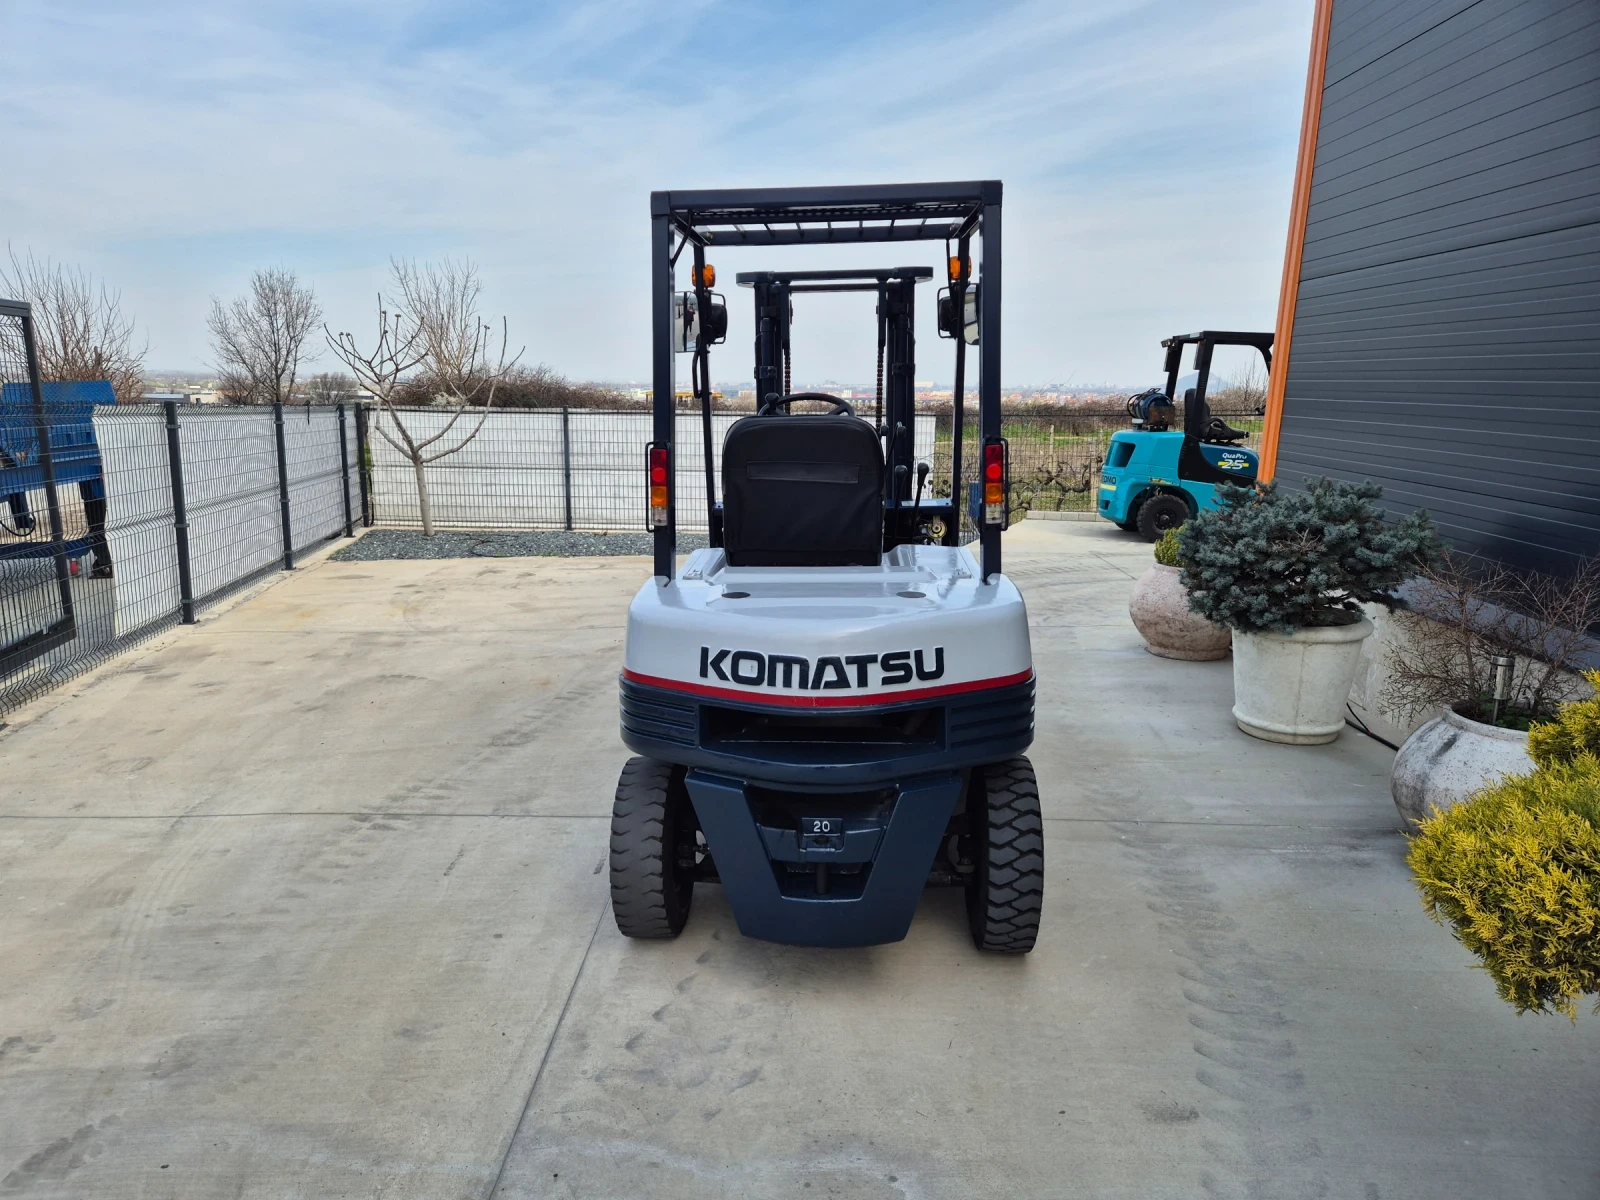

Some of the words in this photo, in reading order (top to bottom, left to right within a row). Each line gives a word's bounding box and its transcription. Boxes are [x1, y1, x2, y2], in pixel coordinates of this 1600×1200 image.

[1221, 459, 1245, 470] 25
[699, 646, 944, 690] KOMATSU
[813, 820, 830, 832] 20
